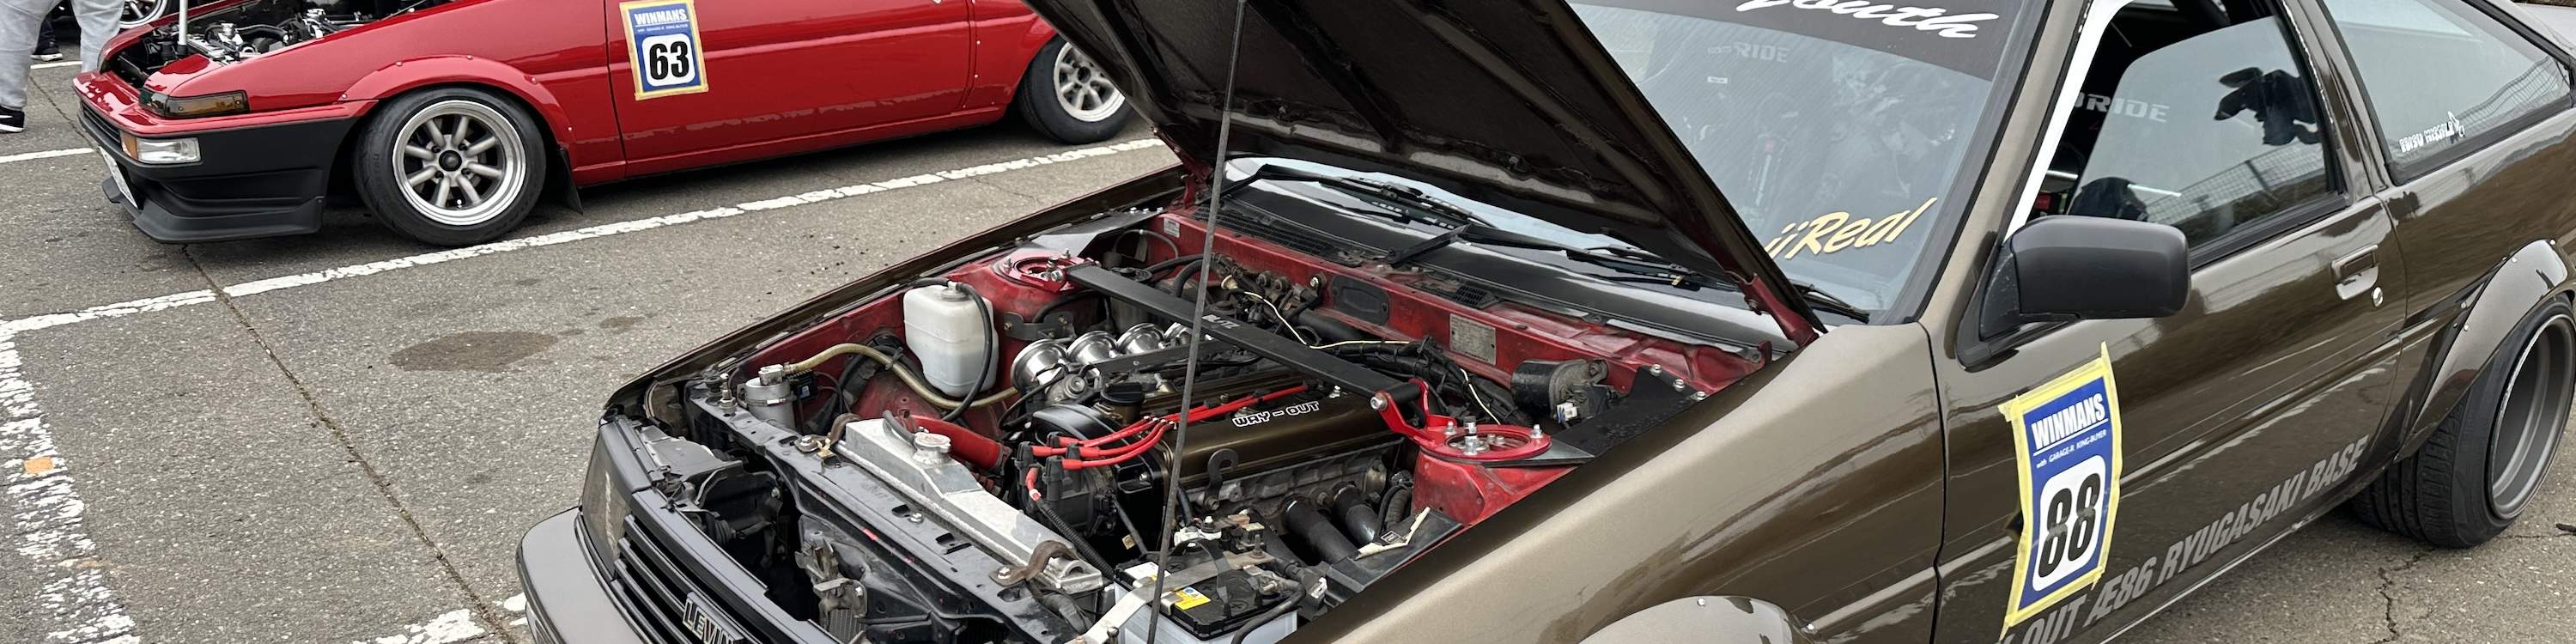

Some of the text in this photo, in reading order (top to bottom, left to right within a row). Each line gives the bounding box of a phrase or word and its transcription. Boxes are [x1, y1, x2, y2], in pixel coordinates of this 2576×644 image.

[634, 9, 688, 25] WINMANS
[1735, 0, 2000, 38] outh
[649, 40, 690, 81] 63
[2031, 393, 2105, 450] WINMANS
[2038, 472, 2101, 578] 88
[2156, 470, 2306, 586] RYUGASAKI
[2302, 434, 2370, 501] BASE
